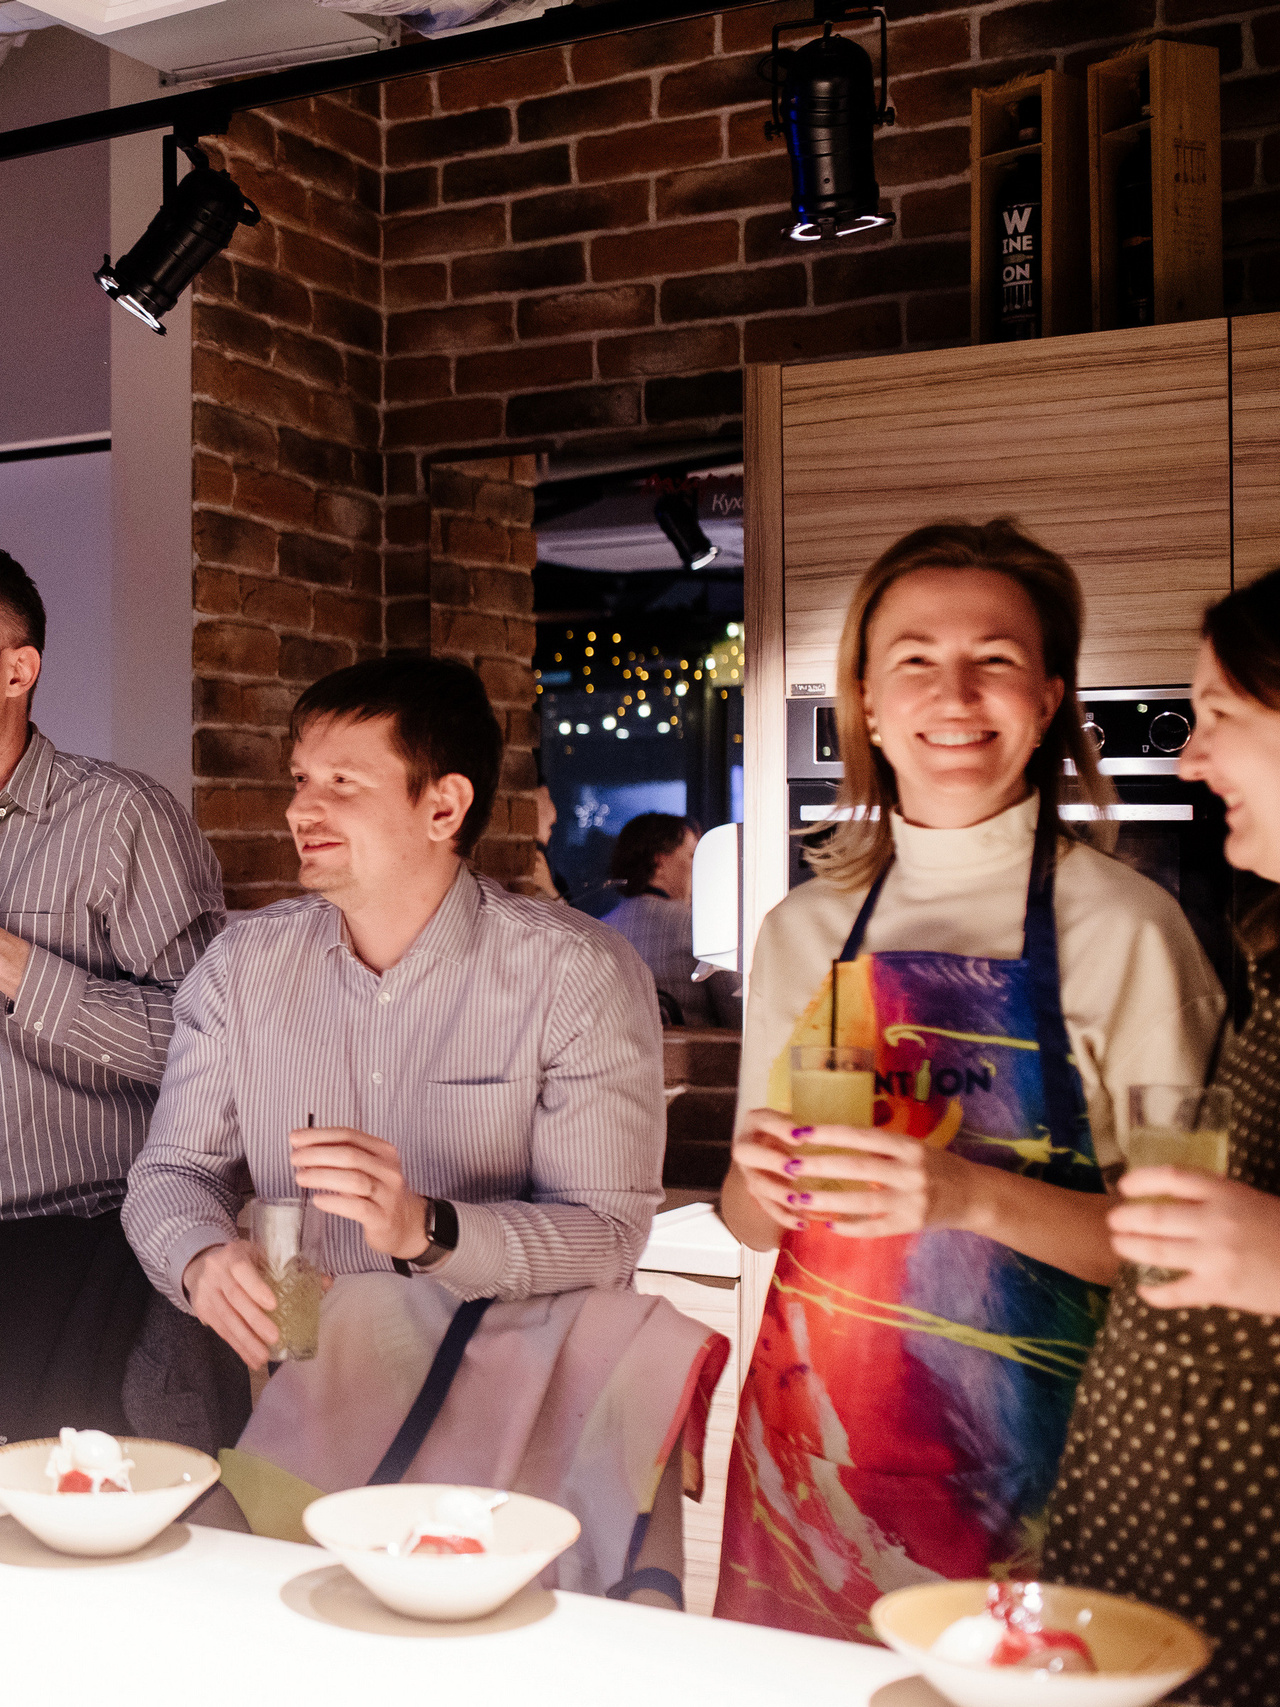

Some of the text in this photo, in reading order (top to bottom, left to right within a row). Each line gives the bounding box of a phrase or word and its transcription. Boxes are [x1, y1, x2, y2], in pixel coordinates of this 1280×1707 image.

[1002, 264, 1030, 282] ON
[712, 493, 743, 516] Кух
[935, 1067, 992, 1097] ON
